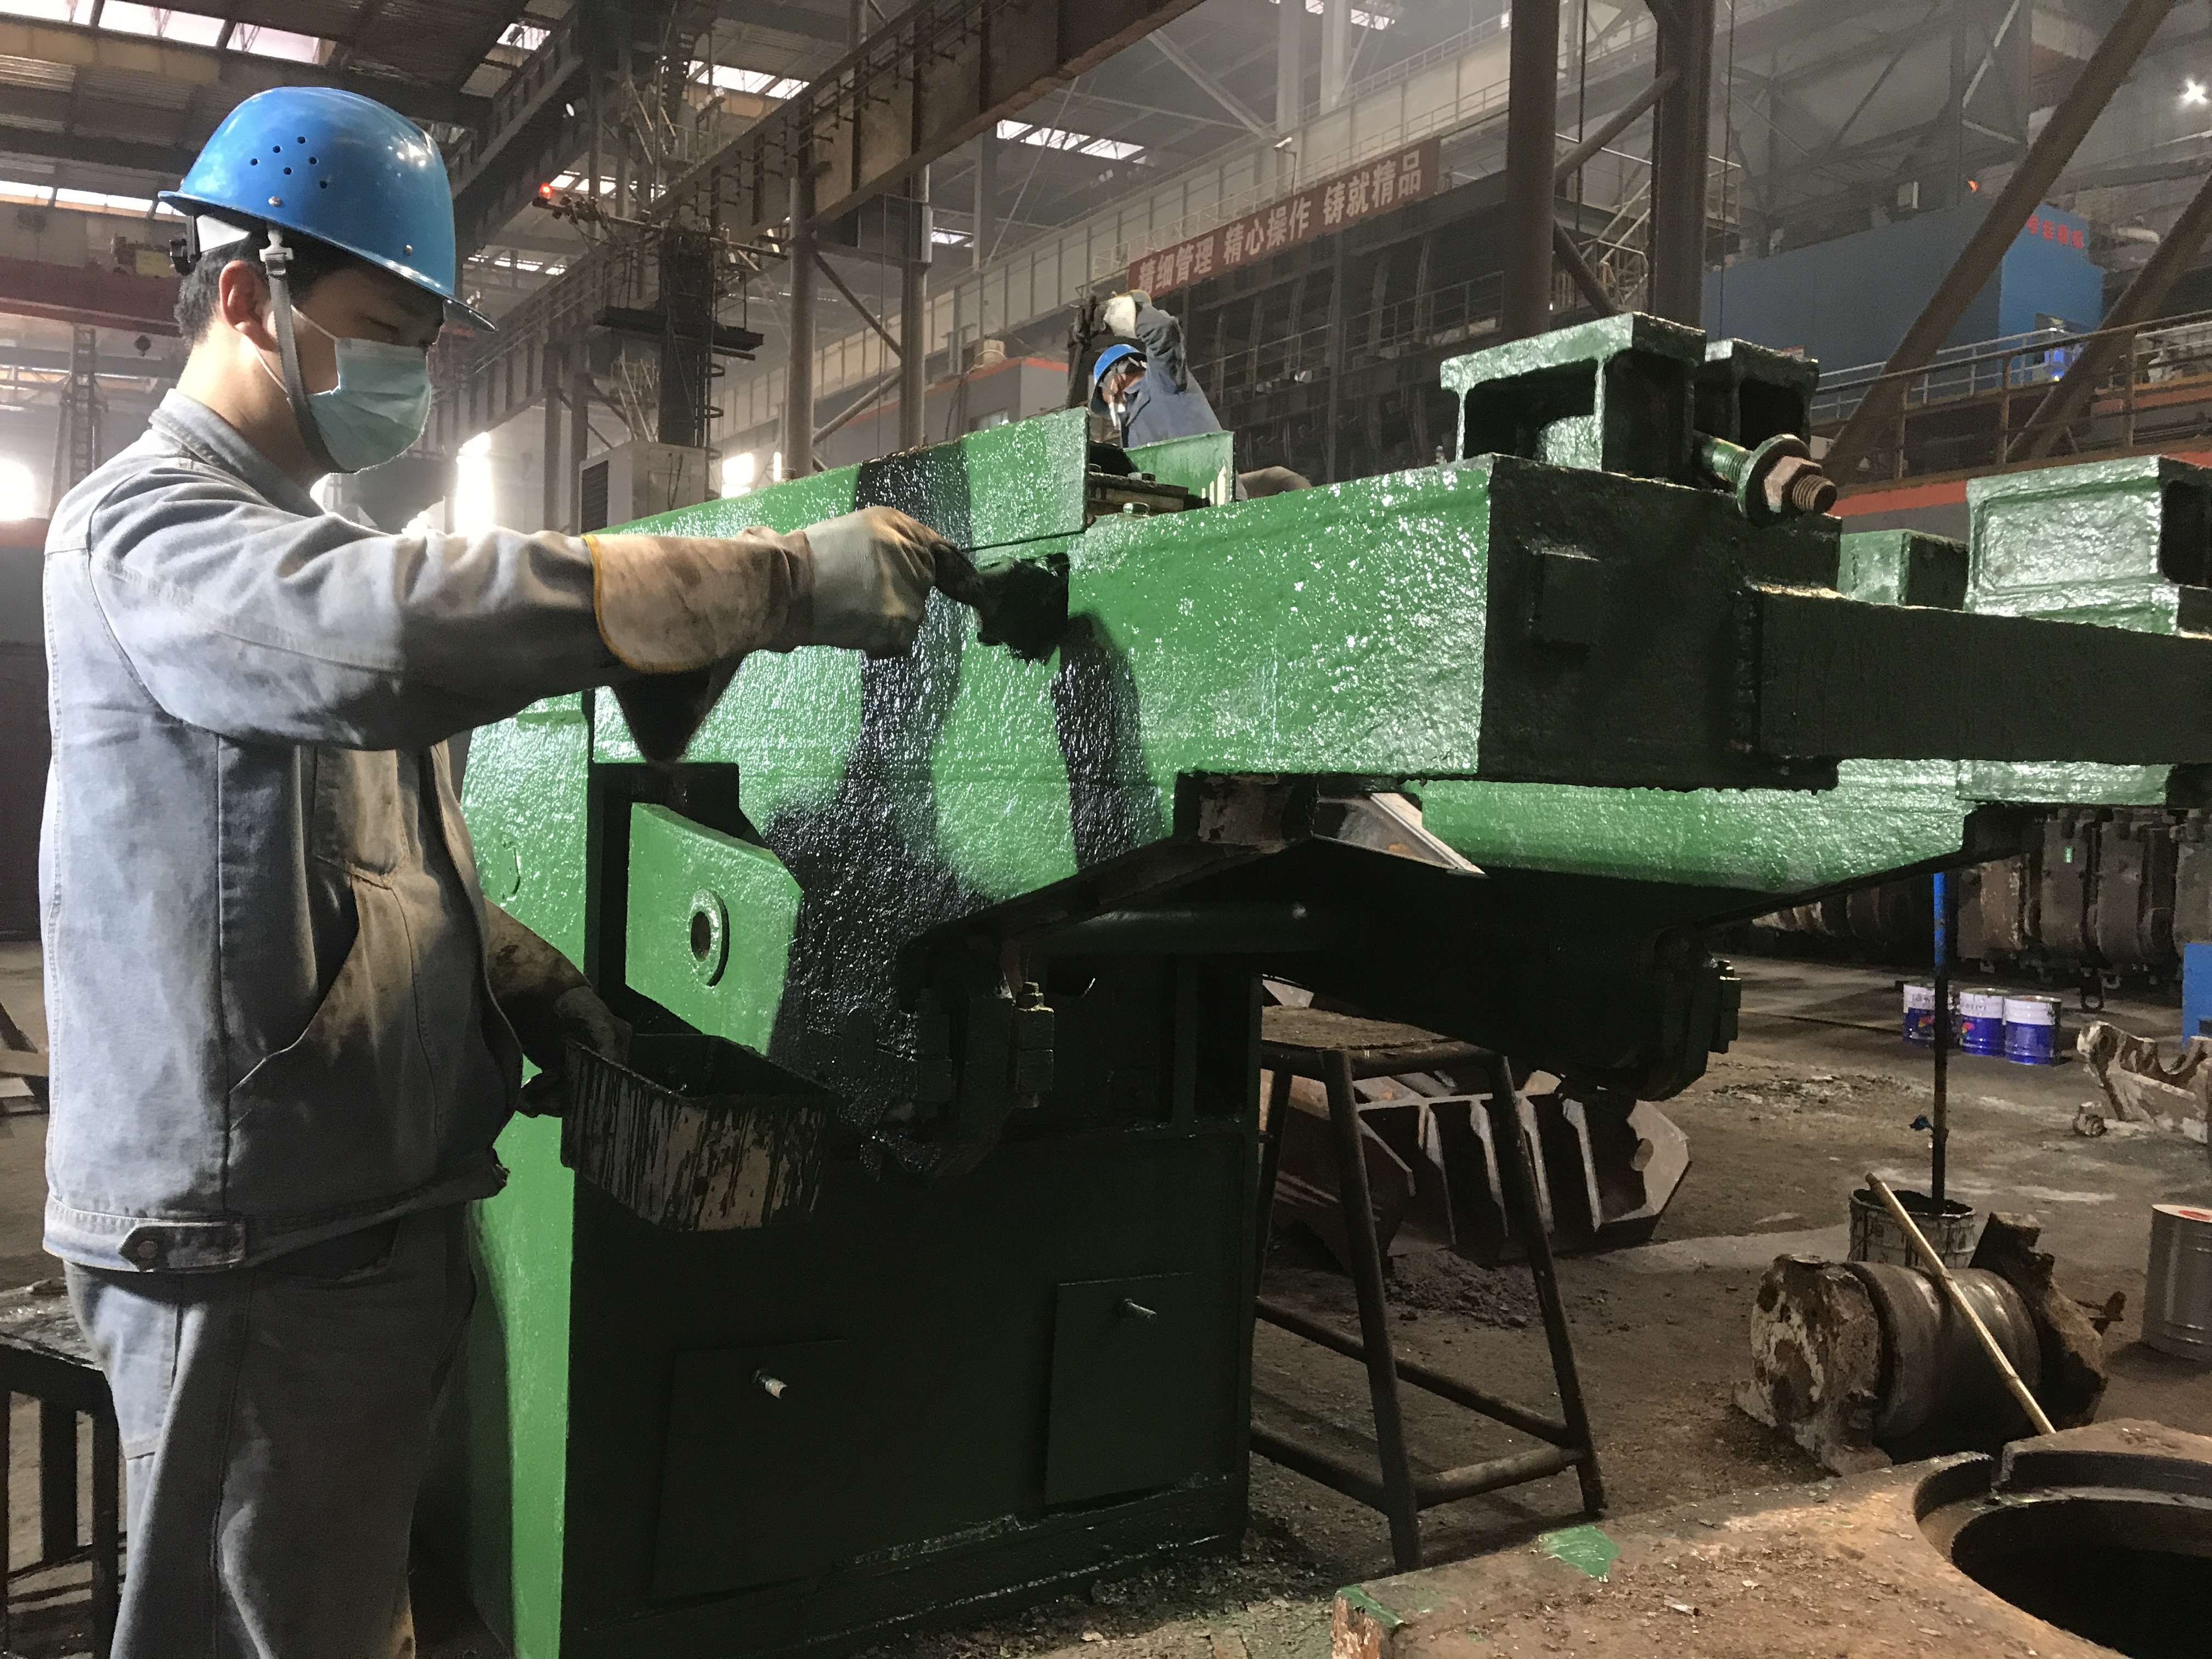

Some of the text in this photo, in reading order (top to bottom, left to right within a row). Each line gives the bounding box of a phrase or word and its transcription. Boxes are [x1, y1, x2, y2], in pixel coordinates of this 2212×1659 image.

[1138, 150, 1422, 295] 精细管理 精心操作 铸就精品
